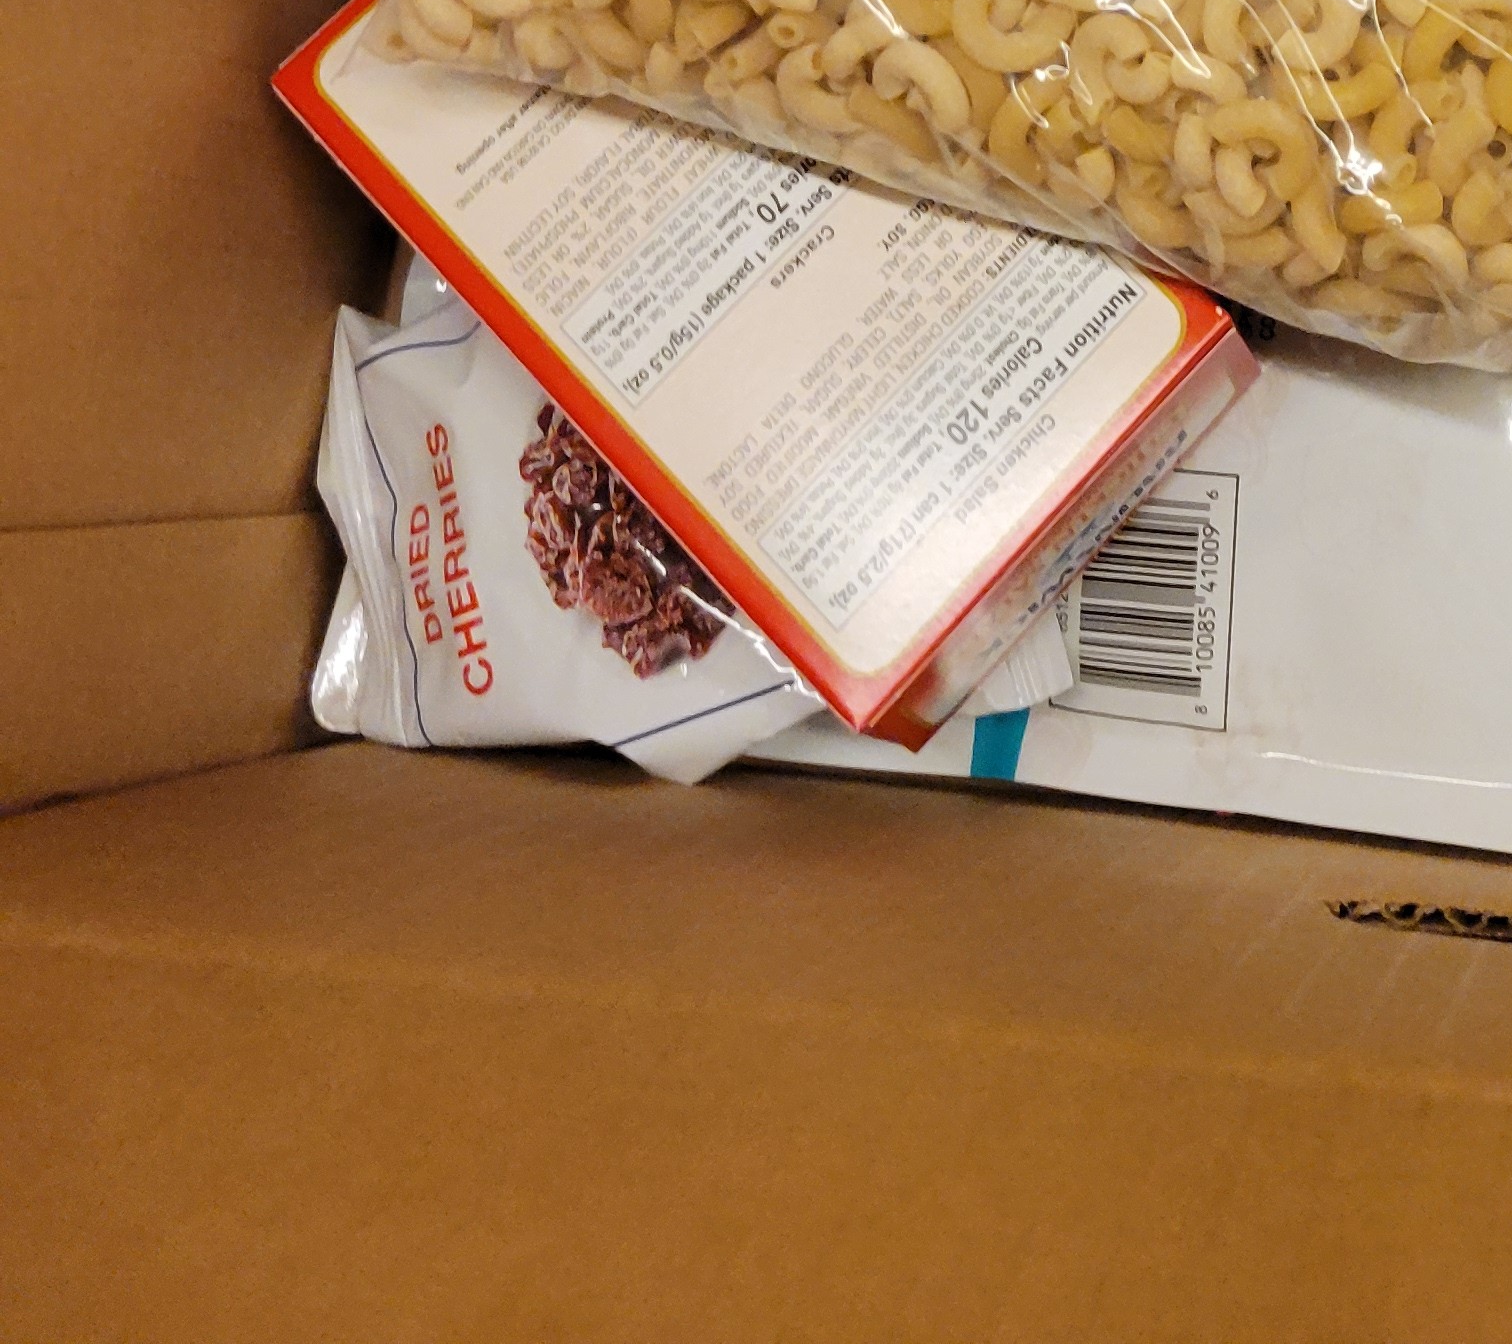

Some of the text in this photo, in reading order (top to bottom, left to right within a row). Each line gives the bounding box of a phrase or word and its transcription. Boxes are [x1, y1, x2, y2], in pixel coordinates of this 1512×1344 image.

[696, 185, 831, 320] Serv. Size: package
[746, 186, 789, 230] 70,
[768, 221, 837, 292] Crackers
[908, 279, 1141, 524] Nutrition Facts Serv. Size: can
[935, 333, 1045, 452] Calories 120,
[951, 411, 1059, 525] Chicken Salad
[1207, 489, 1219, 499] 6
[409, 504, 443, 644] DRIED
[426, 423, 494, 695] CHERRIES
[1198, 525, 1220, 592] 41009
[1194, 606, 1216, 672] 10085
